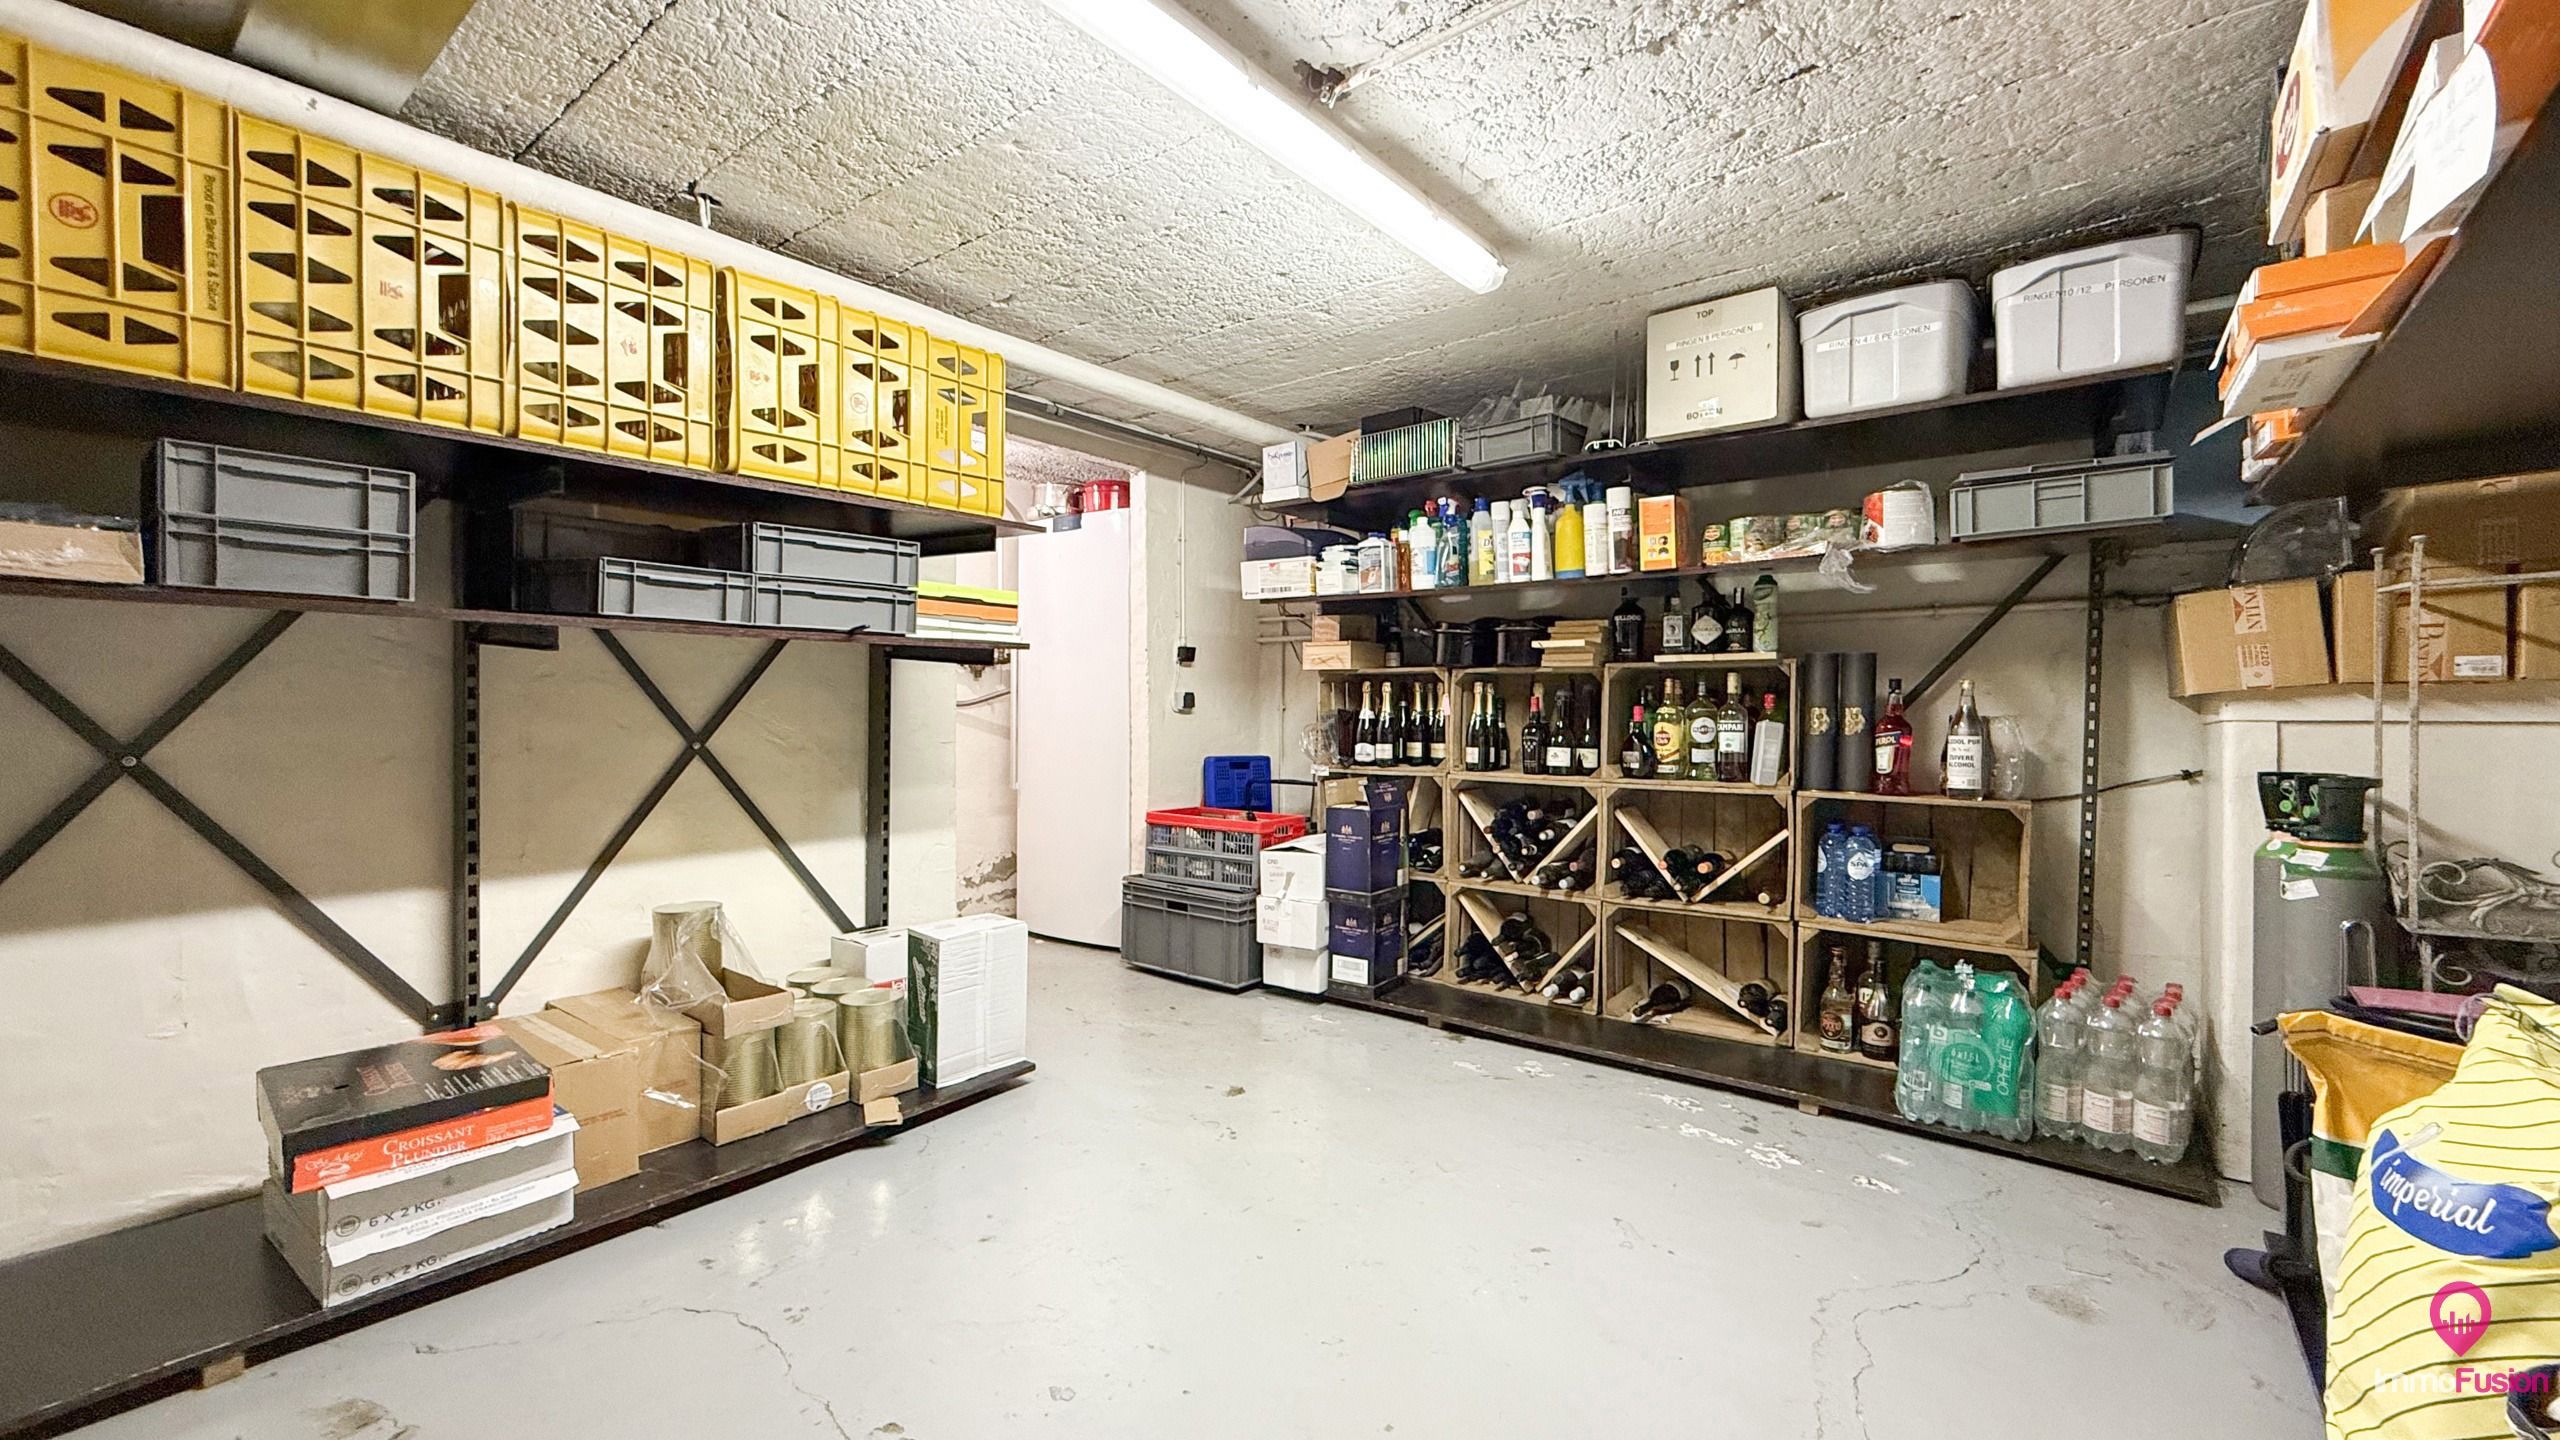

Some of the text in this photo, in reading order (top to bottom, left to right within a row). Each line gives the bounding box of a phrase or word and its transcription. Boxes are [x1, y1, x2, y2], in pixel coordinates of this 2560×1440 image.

[1696, 308, 1714, 319] TOP
[383, 1124, 475, 1156] CROISSANT
[390, 1140, 466, 1169] PLUNDER
[2380, 1158, 2497, 1235] imperial
[368, 1216, 380, 1228] 6
[400, 1207, 411, 1218] 2
[370, 1275, 381, 1286] 6
[402, 1264, 412, 1275] 2
